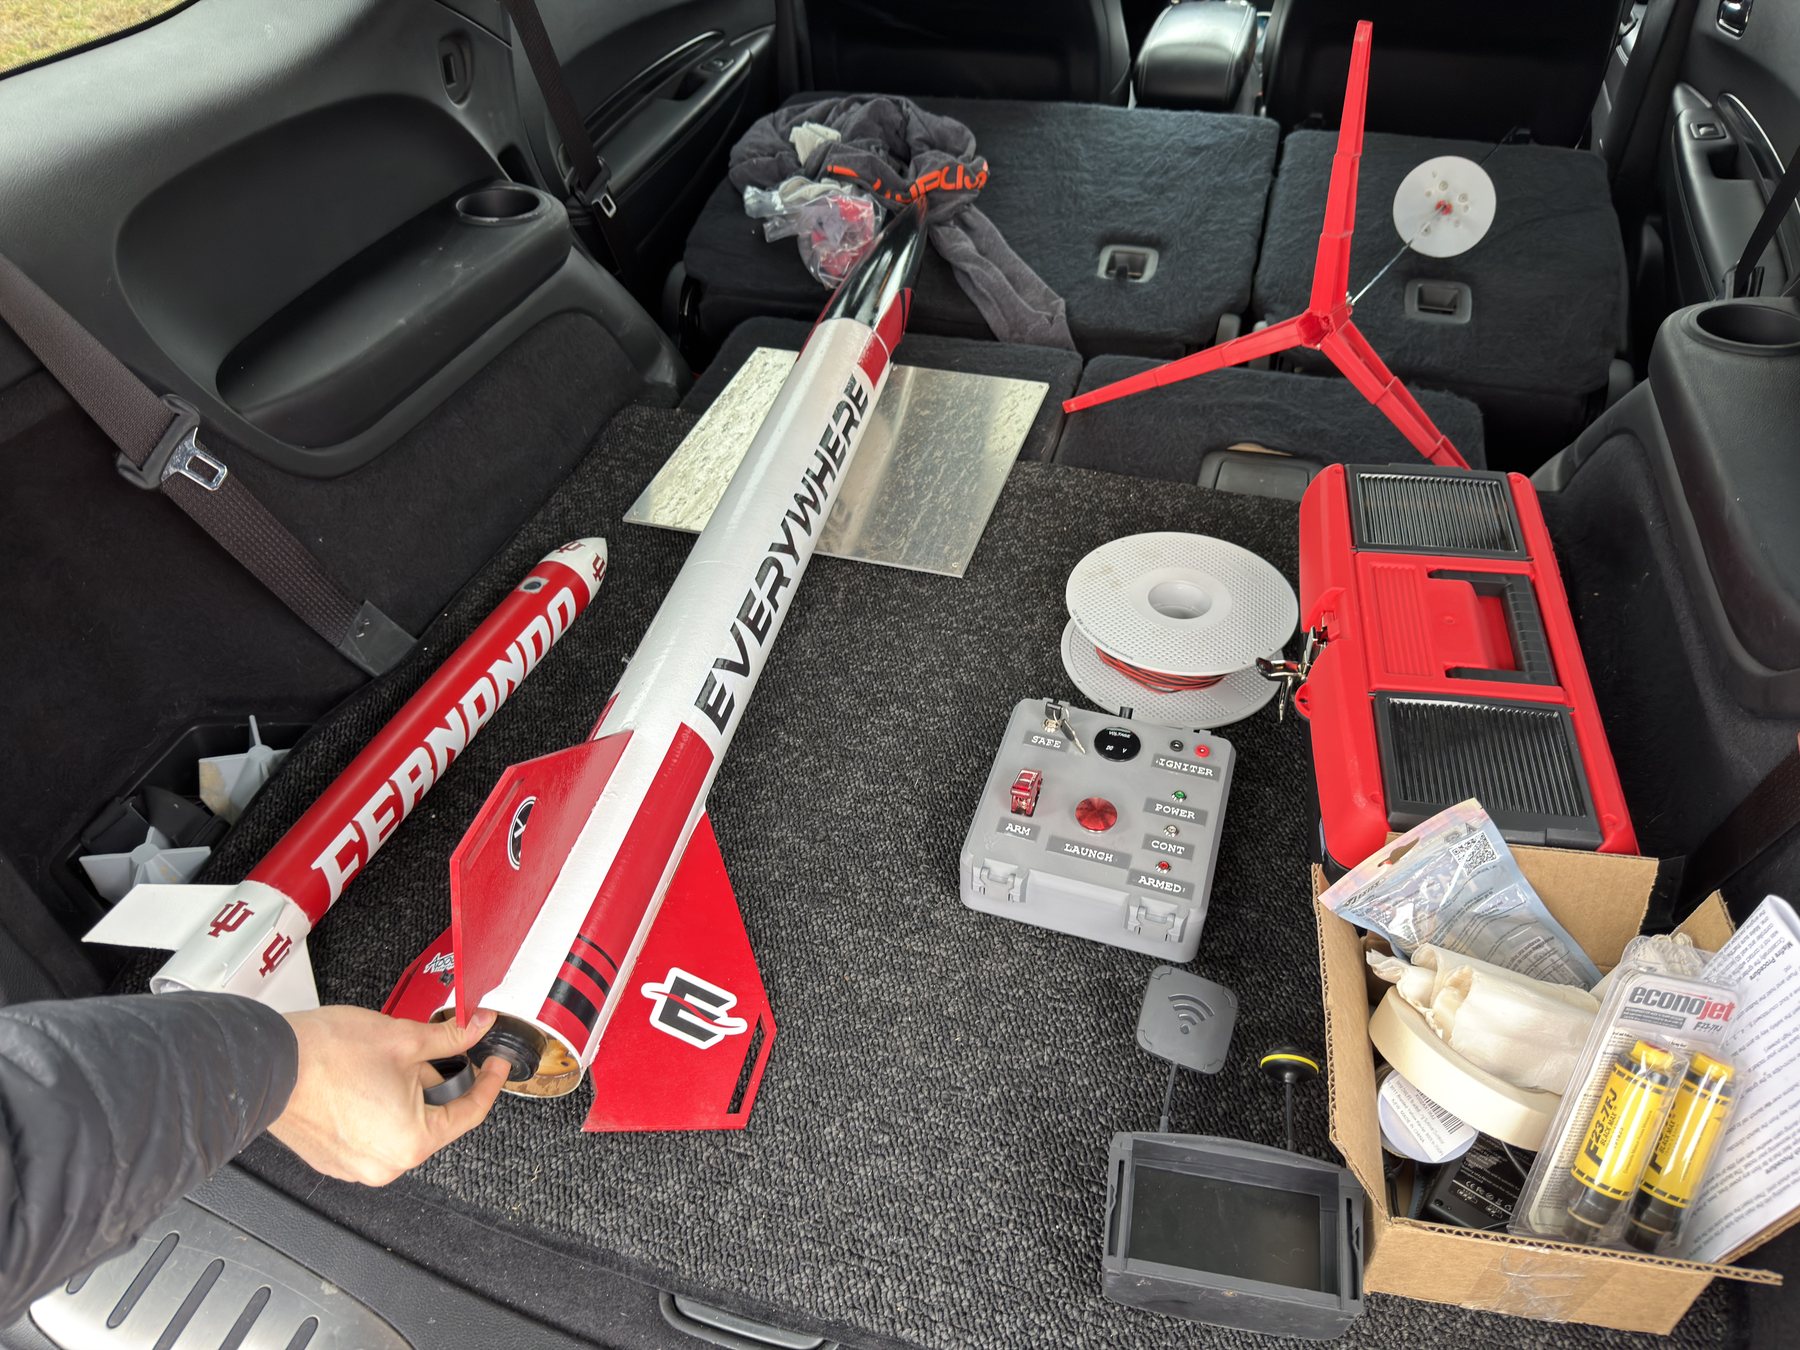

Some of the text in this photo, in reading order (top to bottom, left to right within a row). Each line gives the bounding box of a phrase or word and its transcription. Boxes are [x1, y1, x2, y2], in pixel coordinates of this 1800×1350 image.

[694, 373, 870, 735] EVERYWHERE
[1031, 734, 1061, 749] SAFE
[1158, 757, 1213, 777] IGNITER
[1154, 803, 1196, 820] POWER
[1005, 822, 1031, 836] ARM
[1063, 843, 1114, 863] LAUNCH
[1151, 839, 1185, 854] CONT
[1138, 874, 1182, 893] ARMED
[1773, 940, 1793, 959] Misfire
[1748, 955, 1776, 982] Procedure
[1629, 986, 1735, 1021] econojet
[1585, 1088, 1617, 1167] F23-7FJ
[1600, 1113, 1617, 1146] BLACK MAX
[1660, 1132, 1670, 1154] BLACK
